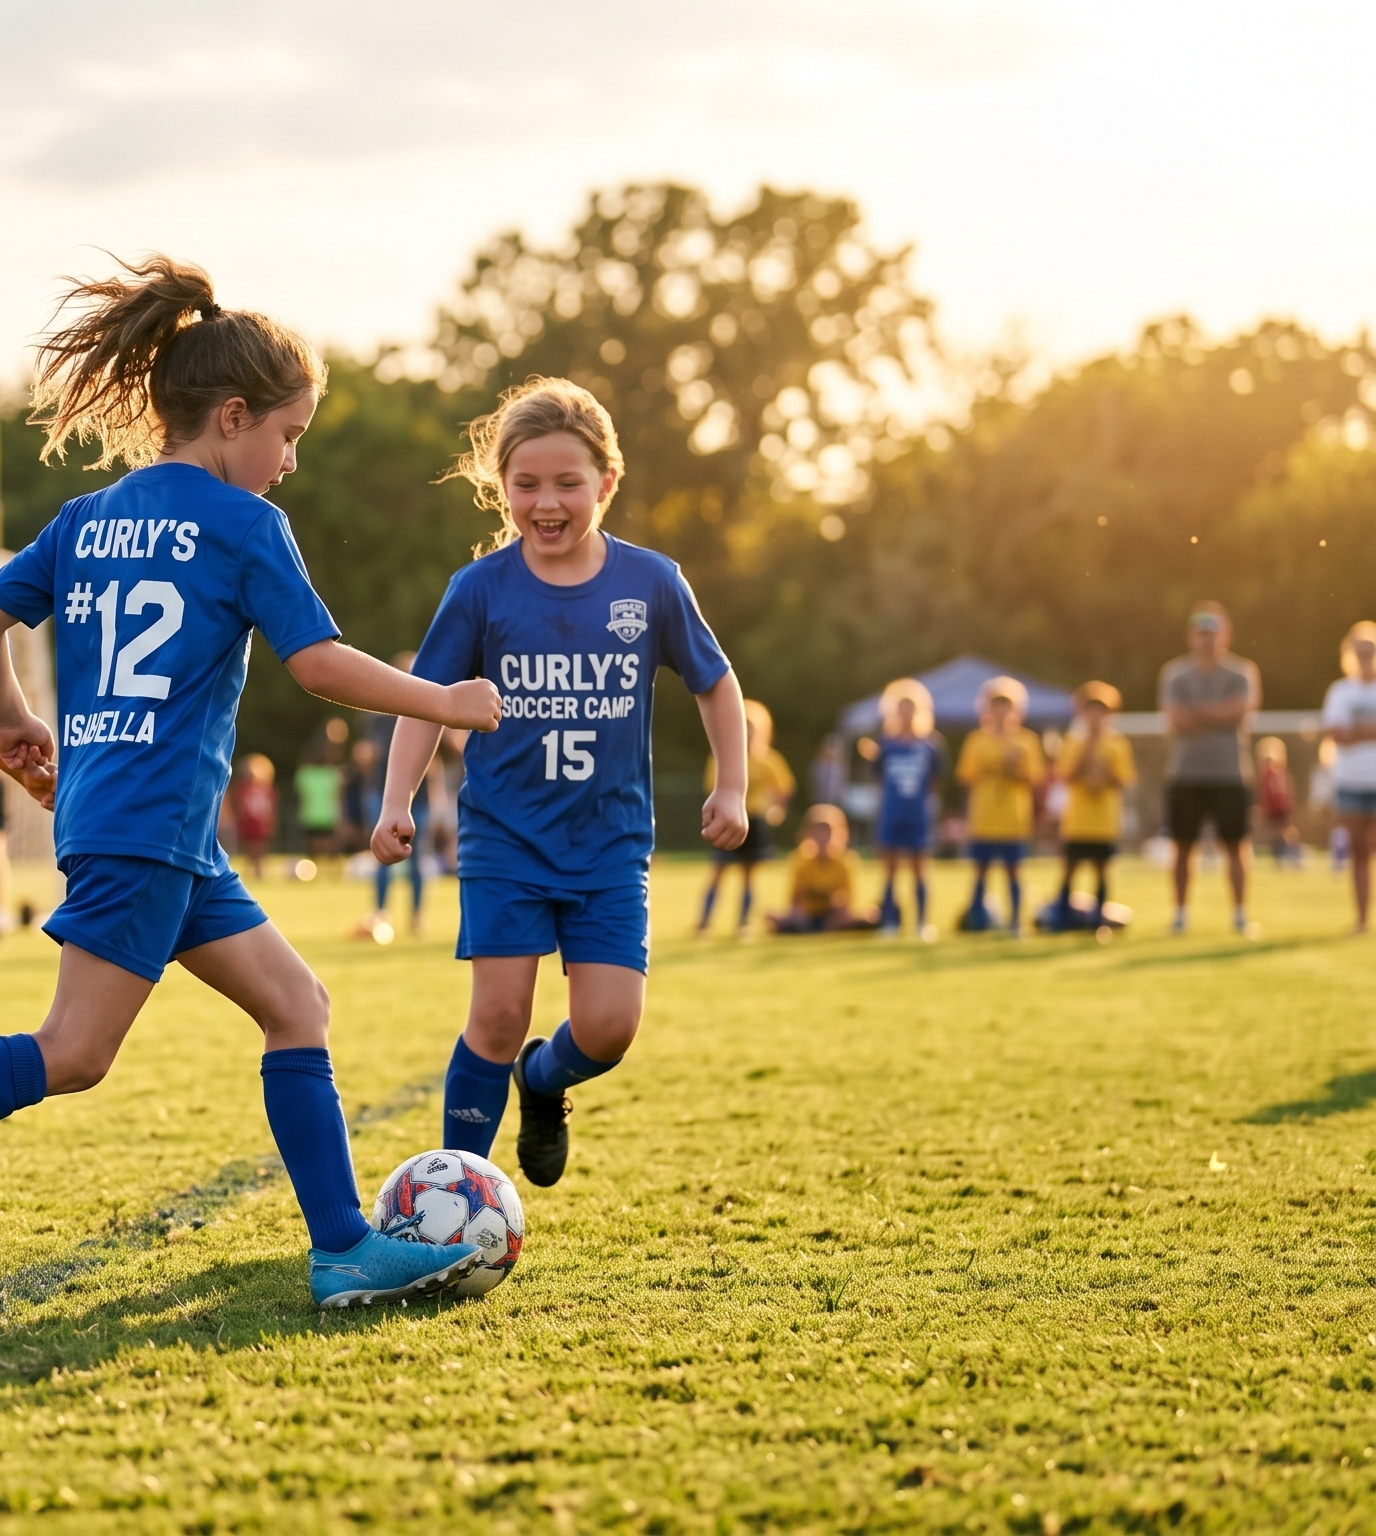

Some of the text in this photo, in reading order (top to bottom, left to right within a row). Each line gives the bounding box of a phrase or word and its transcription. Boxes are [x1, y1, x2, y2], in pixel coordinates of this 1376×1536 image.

[75, 518, 200, 562] CURLY'S
[500, 653, 640, 691] CURLY'S
[501, 694, 636, 720] SOCCER CAMP
[541, 729, 597, 782] 15
